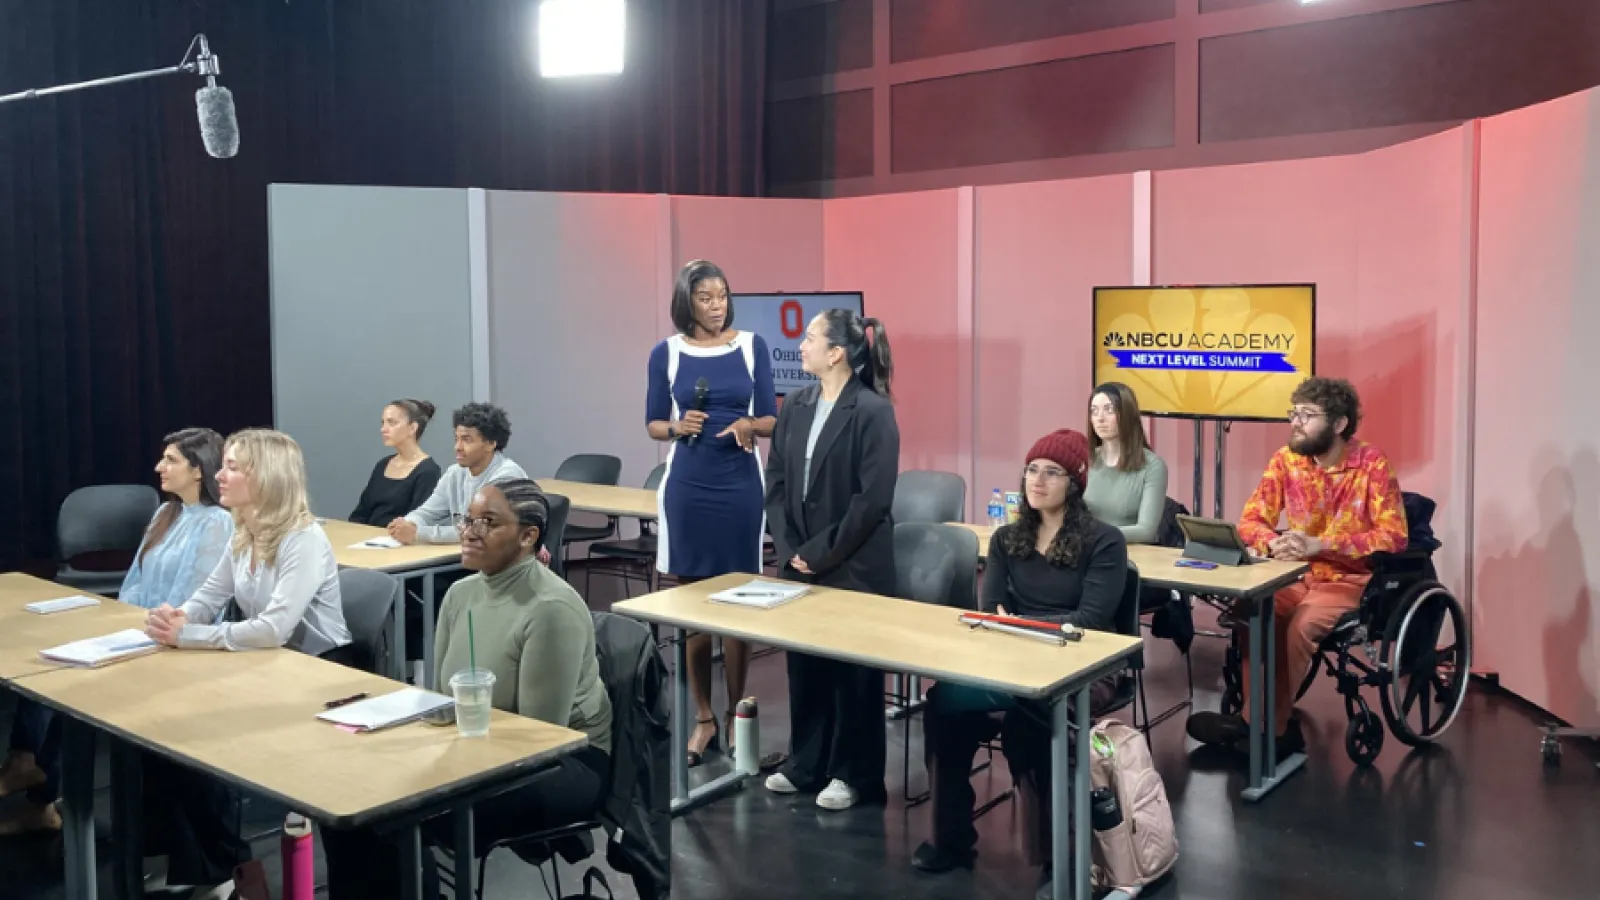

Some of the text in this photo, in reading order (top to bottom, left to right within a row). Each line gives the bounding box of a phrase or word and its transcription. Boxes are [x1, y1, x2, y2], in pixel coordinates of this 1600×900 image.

[780, 300, 803, 339] O
[1126, 332, 1295, 350] NBCU ACADEMY
[1131, 353, 1262, 368] NEXT LEVEL SUMMIT
